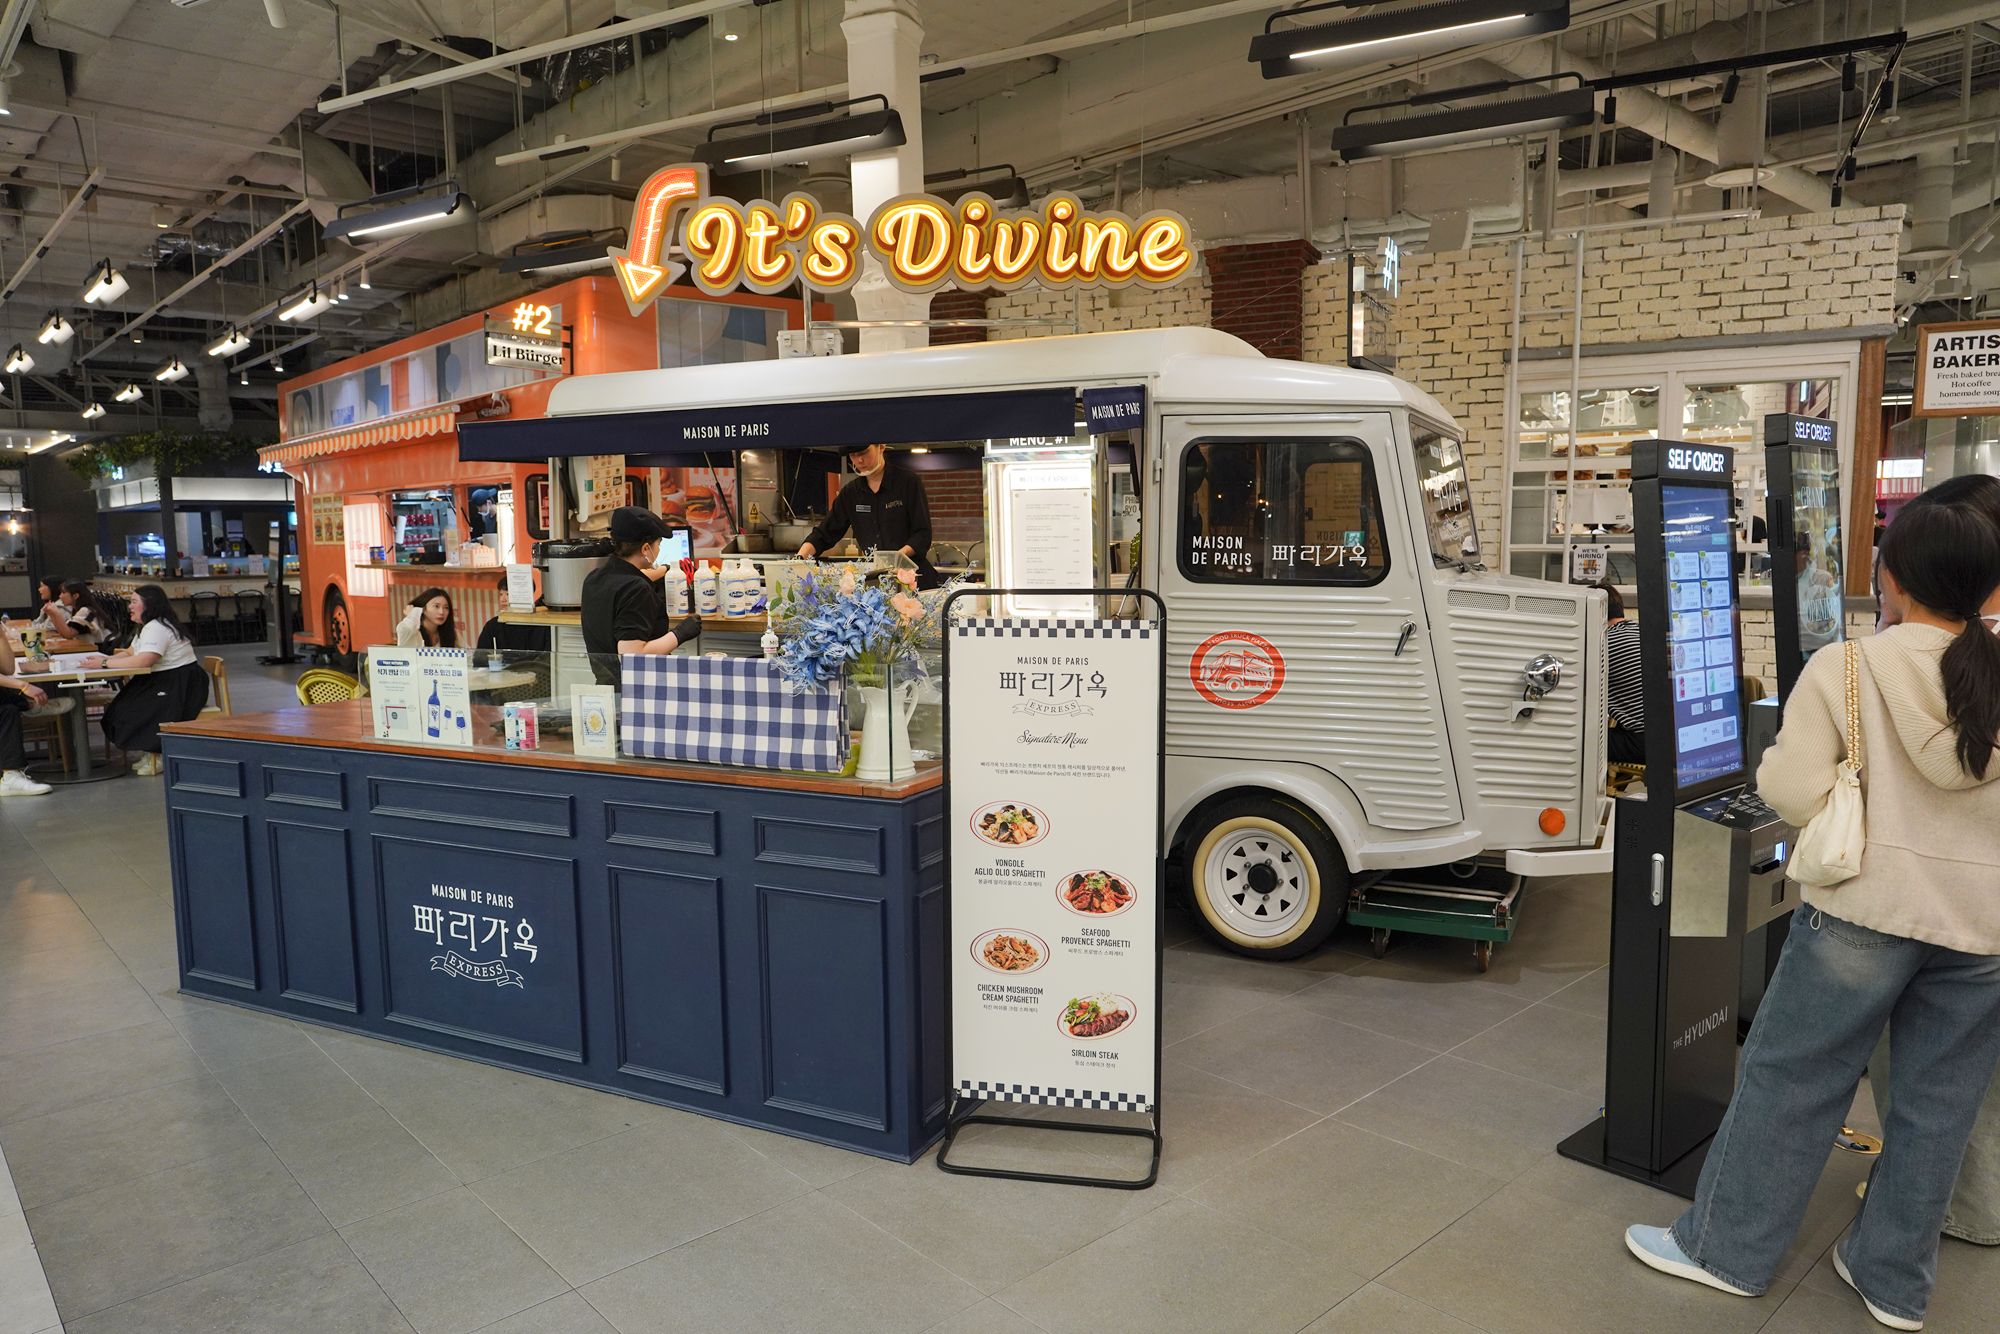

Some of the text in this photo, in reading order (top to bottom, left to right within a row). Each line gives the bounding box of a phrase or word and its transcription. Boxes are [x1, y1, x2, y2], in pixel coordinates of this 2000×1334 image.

[688, 198, 1190, 282] It's Divine
[512, 302, 552, 335] #2
[493, 345, 566, 366] Lil Bürger
[1937, 371, 1959, 379] Fresh
[1967, 380, 1991, 388] coffee
[1092, 402, 1140, 420] MAISON DE PARIS
[683, 423, 769, 440] MAISON DE PARIS
[1794, 421, 1831, 441] SELF ORDER
[1668, 448, 1725, 472] SELF ORDER
[1192, 536, 1243, 550] MAISON
[1192, 552, 1252, 566] DE PARIS
[1272, 543, 1368, 567] 빠리가옥
[1017, 656, 1089, 666] MAISON DE PARIS
[999, 670, 1108, 698] 빠리가옥
[1029, 701, 1077, 713] EXPRESS
[1016, 729, 1089, 749] Signature Menu
[995, 859, 1025, 868] VONGOLE
[974, 868, 1046, 879] AGLIO OLIO SPAGHETTI
[431, 883, 514, 909] MAISON DE PARIS
[412, 904, 538, 964] 빠리가옥
[1081, 928, 1111, 937] SEAFOOD
[1061, 937, 1131, 948] PROVENCE SPAGHETTI
[449, 955, 503, 978] EXPRESS
[977, 984, 1044, 995] CHICKEN MUSHROOM
[982, 994, 1039, 1004] CREAM SPAGHETTI
[1673, 1005, 1728, 1049] THE HYUNDAI
[1071, 1049, 1119, 1060] SIRLOIN STEAK
